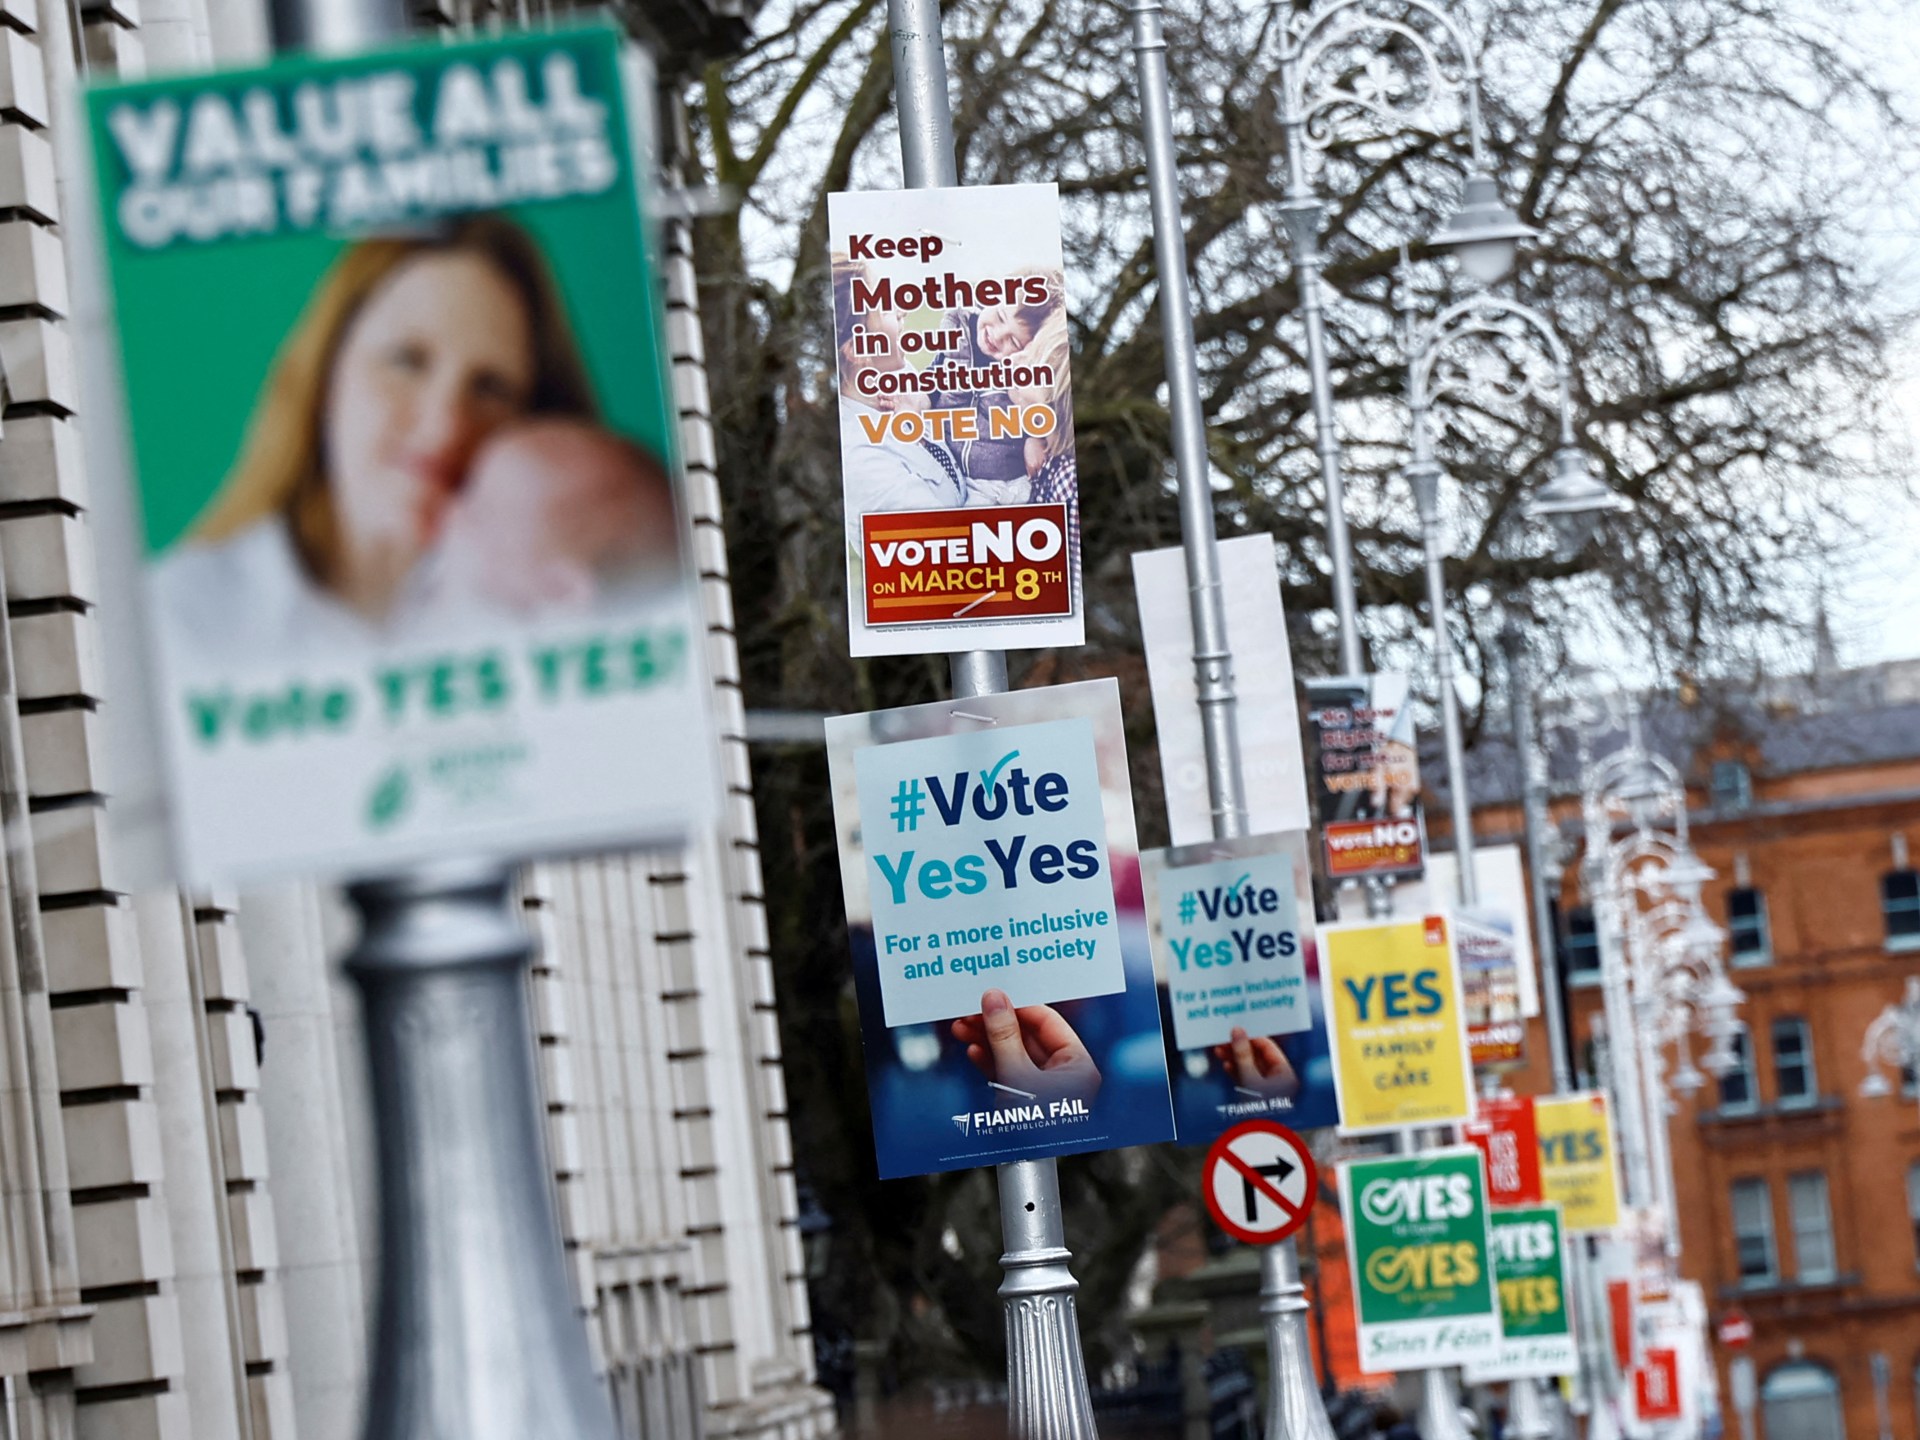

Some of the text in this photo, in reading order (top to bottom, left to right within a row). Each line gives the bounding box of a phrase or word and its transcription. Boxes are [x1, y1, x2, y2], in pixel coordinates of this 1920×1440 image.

[111, 53, 605, 174] VALUE ALL
[115, 139, 616, 247] OUR FAMILIES
[849, 234, 943, 263] Keep
[852, 273, 1048, 312] Mothers
[854, 326, 962, 355] in our
[857, 358, 1053, 395] Constitution
[859, 404, 1056, 444] VOTE NO
[870, 518, 1062, 567] VOTE NO
[873, 582, 895, 594] ON
[900, 566, 1005, 593] MARCH
[186, 679, 353, 751] Vote
[374, 646, 510, 720] YES
[890, 766, 1069, 833] #Vote
[1323, 773, 1378, 793] VOTE
[1331, 821, 1418, 850] VOTE NO
[873, 835, 1100, 904] YesYes
[1178, 884, 1279, 925] #Vote
[885, 908, 1109, 955] For a more inclusive
[1170, 928, 1297, 972] YesYes
[904, 936, 1096, 980] and equal society
[1176, 974, 1302, 1005] For a more inclusive
[1186, 993, 1296, 1020] and equal society
[1344, 969, 1444, 1021] YES
[1362, 1038, 1436, 1060] FAMILY
[1373, 1067, 1431, 1092] CARE
[974, 1097, 1090, 1128] FIANNA FÁIL
[976, 1115, 1090, 1136] THE REPUBLICAN PARTY
[1227, 1100, 1267, 1117] FIANNA
[1538, 1128, 1605, 1164] YES
[1403, 1172, 1475, 1222] YES
[1497, 1220, 1555, 1262] YES
[1407, 1240, 1481, 1288] YES
[1499, 1274, 1560, 1316] YES
